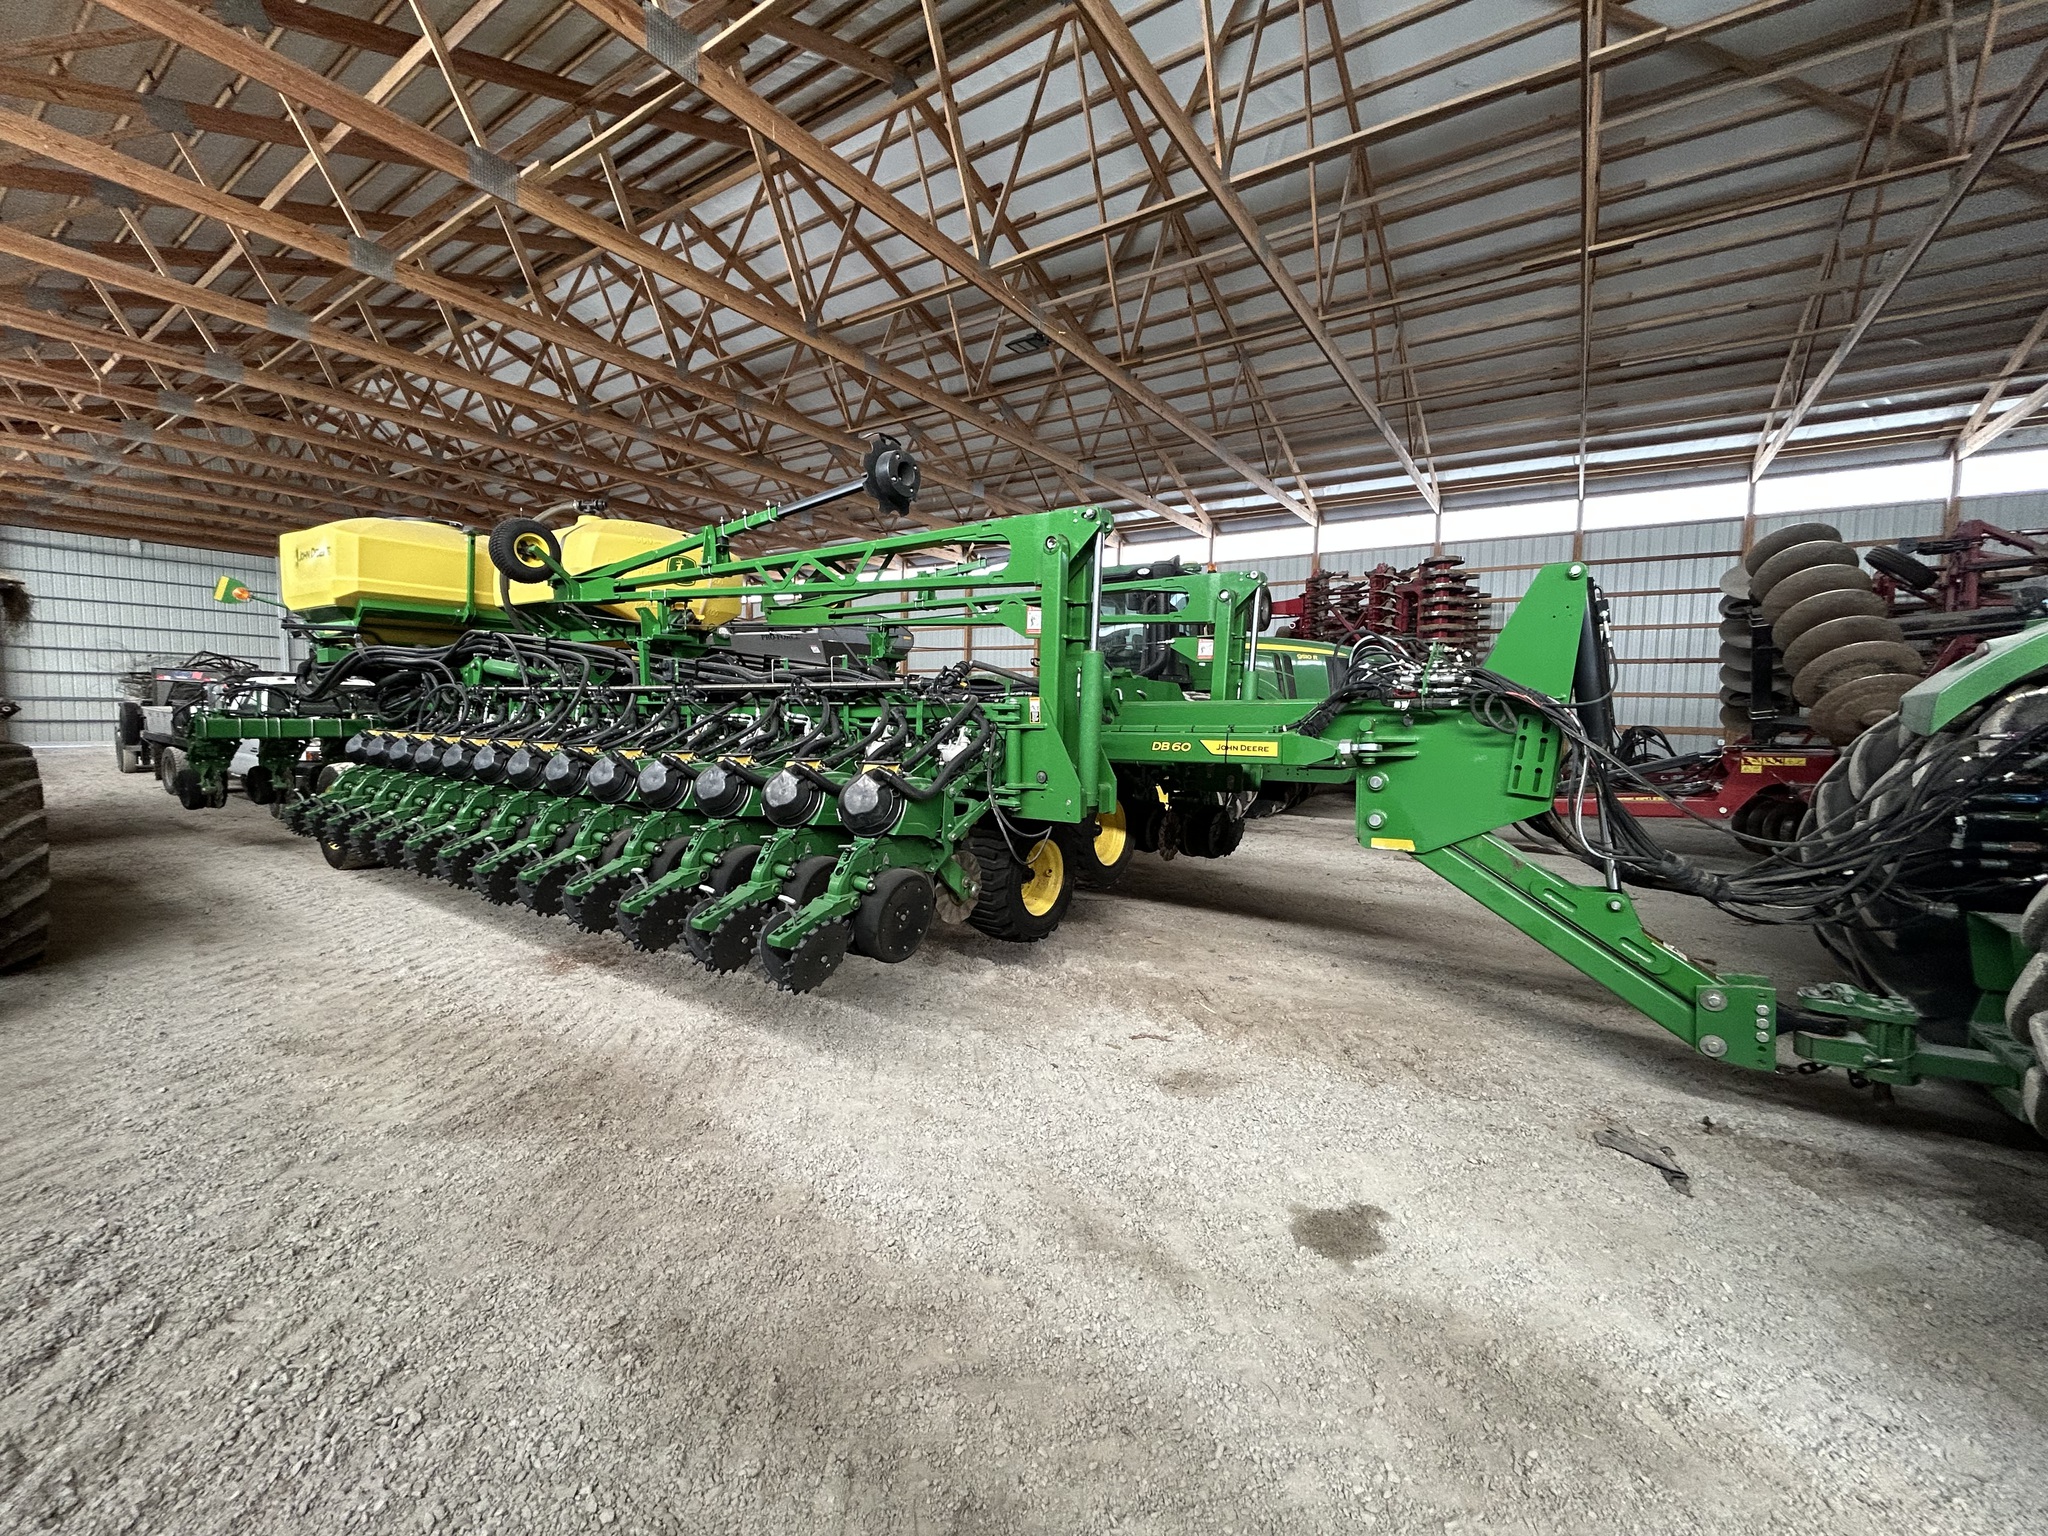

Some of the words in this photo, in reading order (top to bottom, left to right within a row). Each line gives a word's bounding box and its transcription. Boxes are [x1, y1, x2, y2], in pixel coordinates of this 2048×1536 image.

[311, 546, 331, 558] DEEE
[1216, 743, 1239, 751] JOHN
[1240, 744, 1270, 753] DEERE
